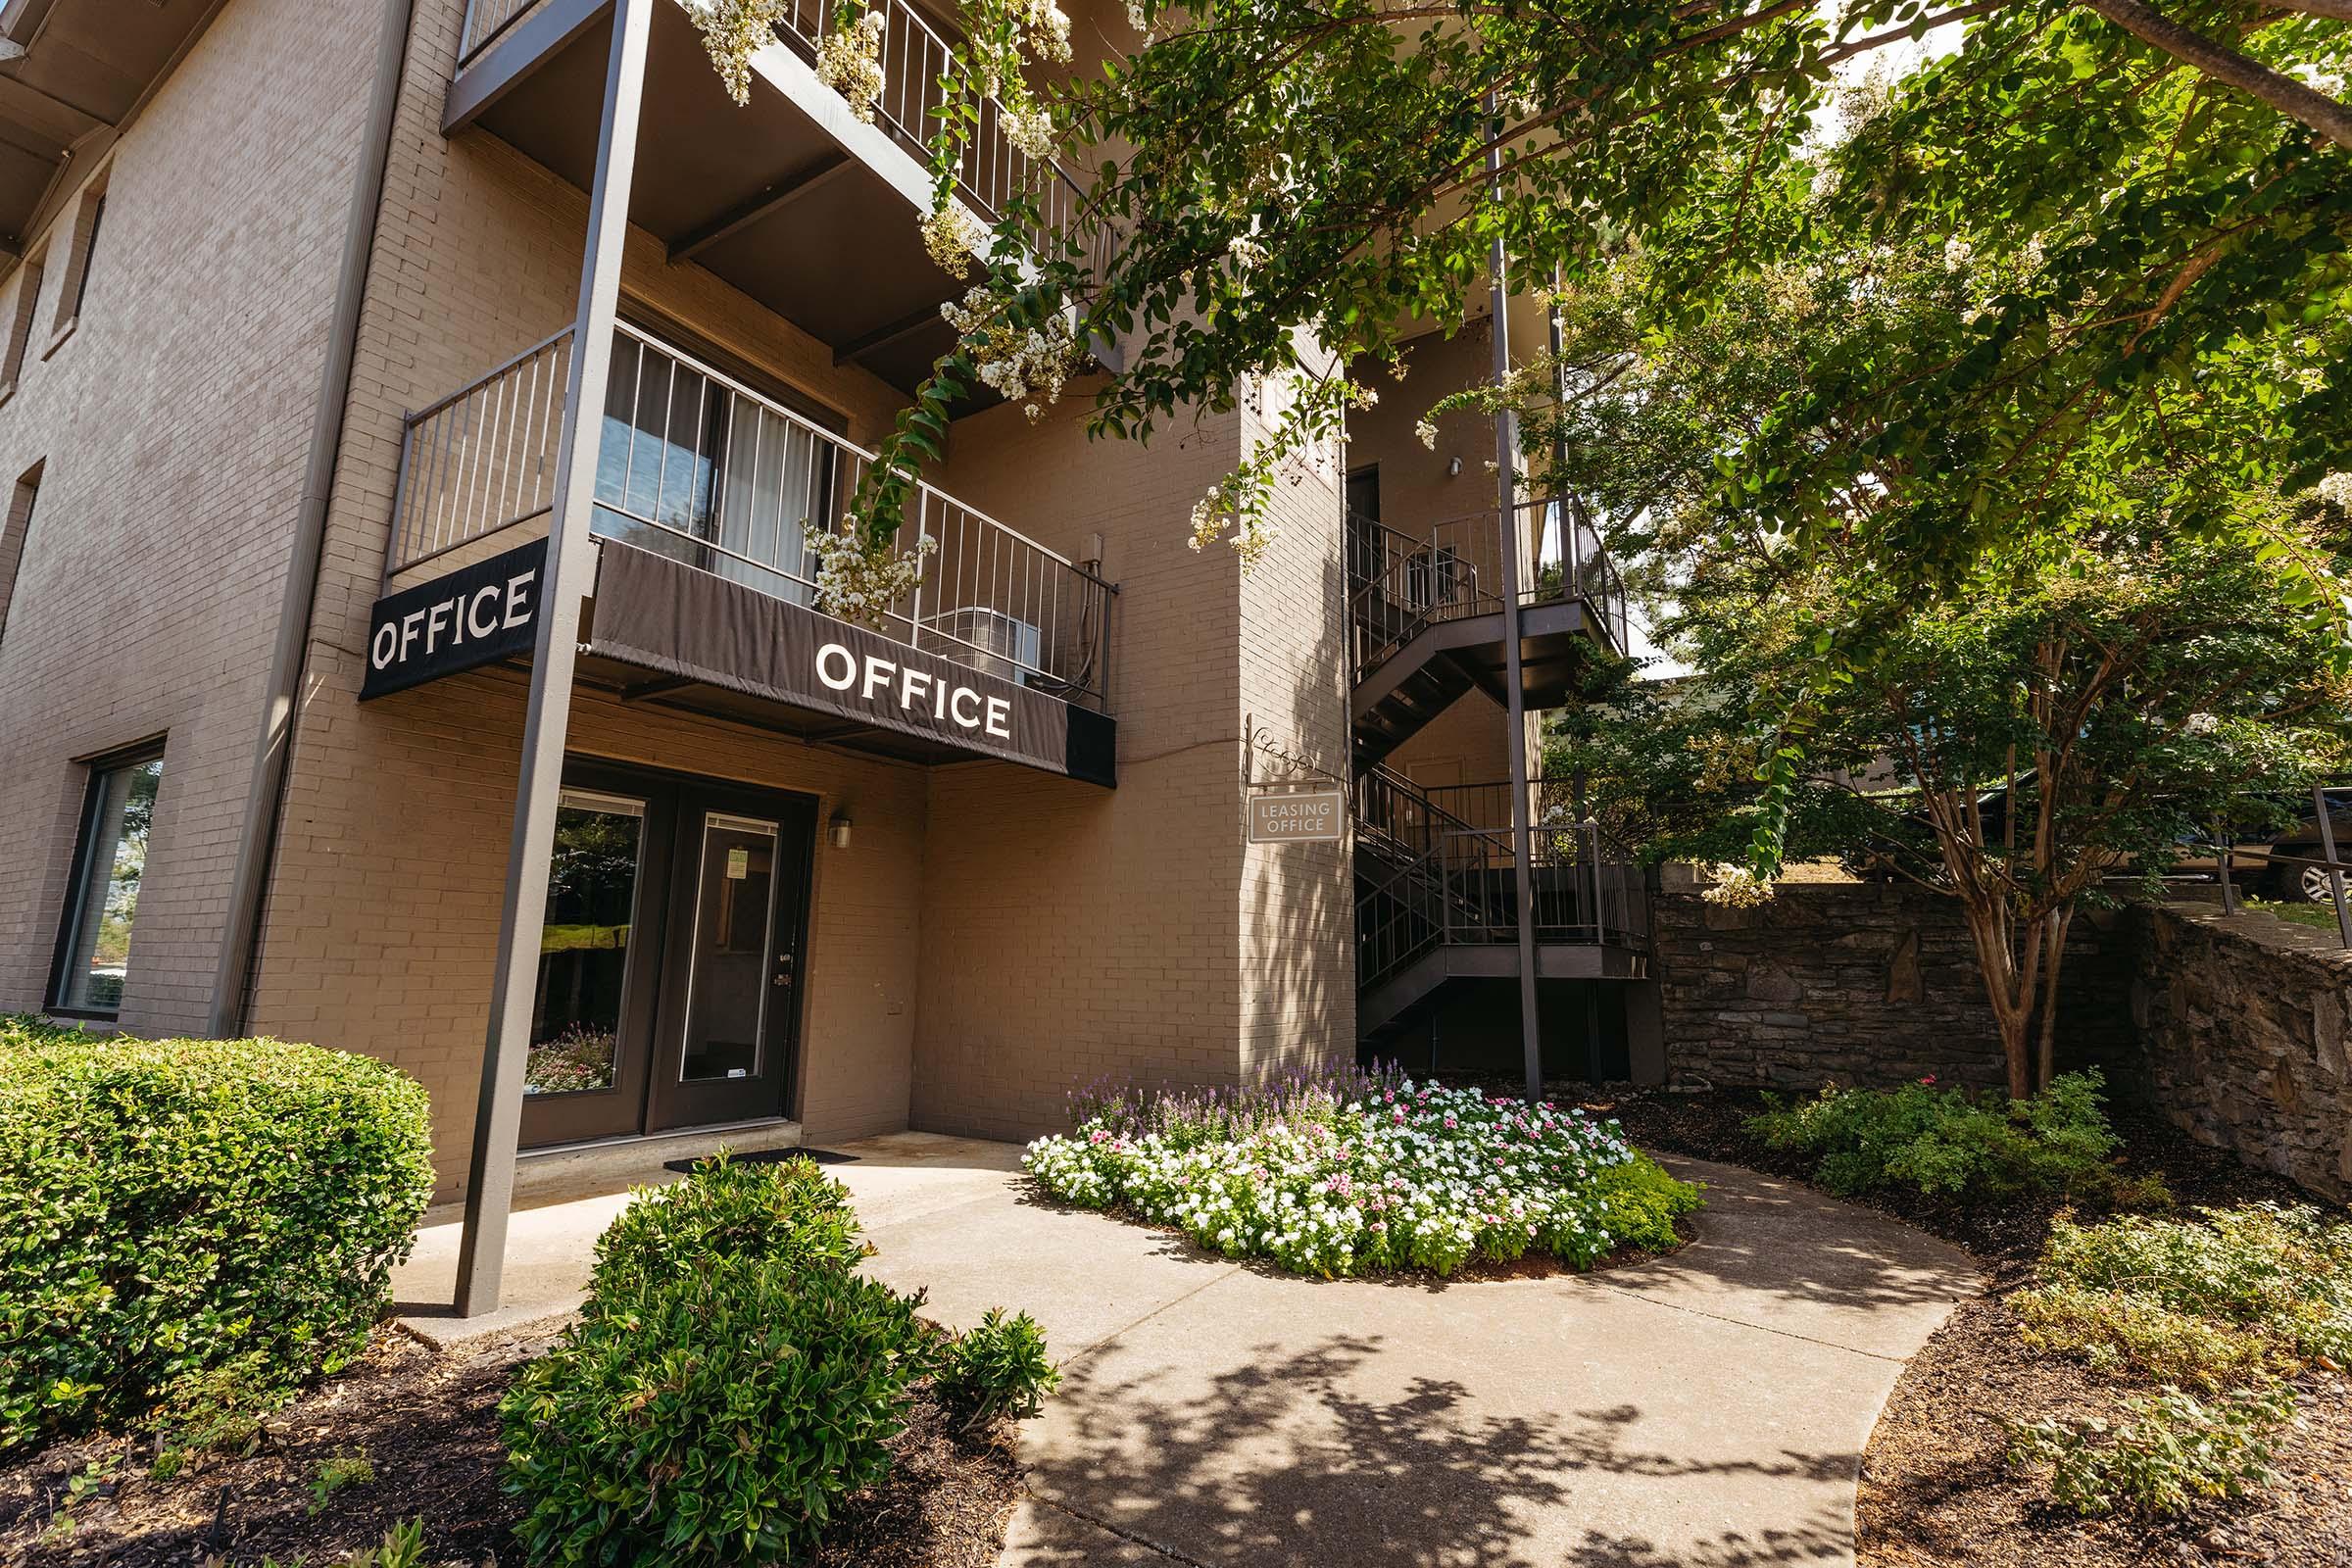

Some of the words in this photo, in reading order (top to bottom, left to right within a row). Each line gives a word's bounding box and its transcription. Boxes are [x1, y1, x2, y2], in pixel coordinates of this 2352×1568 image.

[372, 567, 536, 670] OFFICE
[815, 643, 1011, 740] OFFICE
[1261, 802, 1330, 818] LEASING
[1266, 817, 1325, 833] OFFICE
